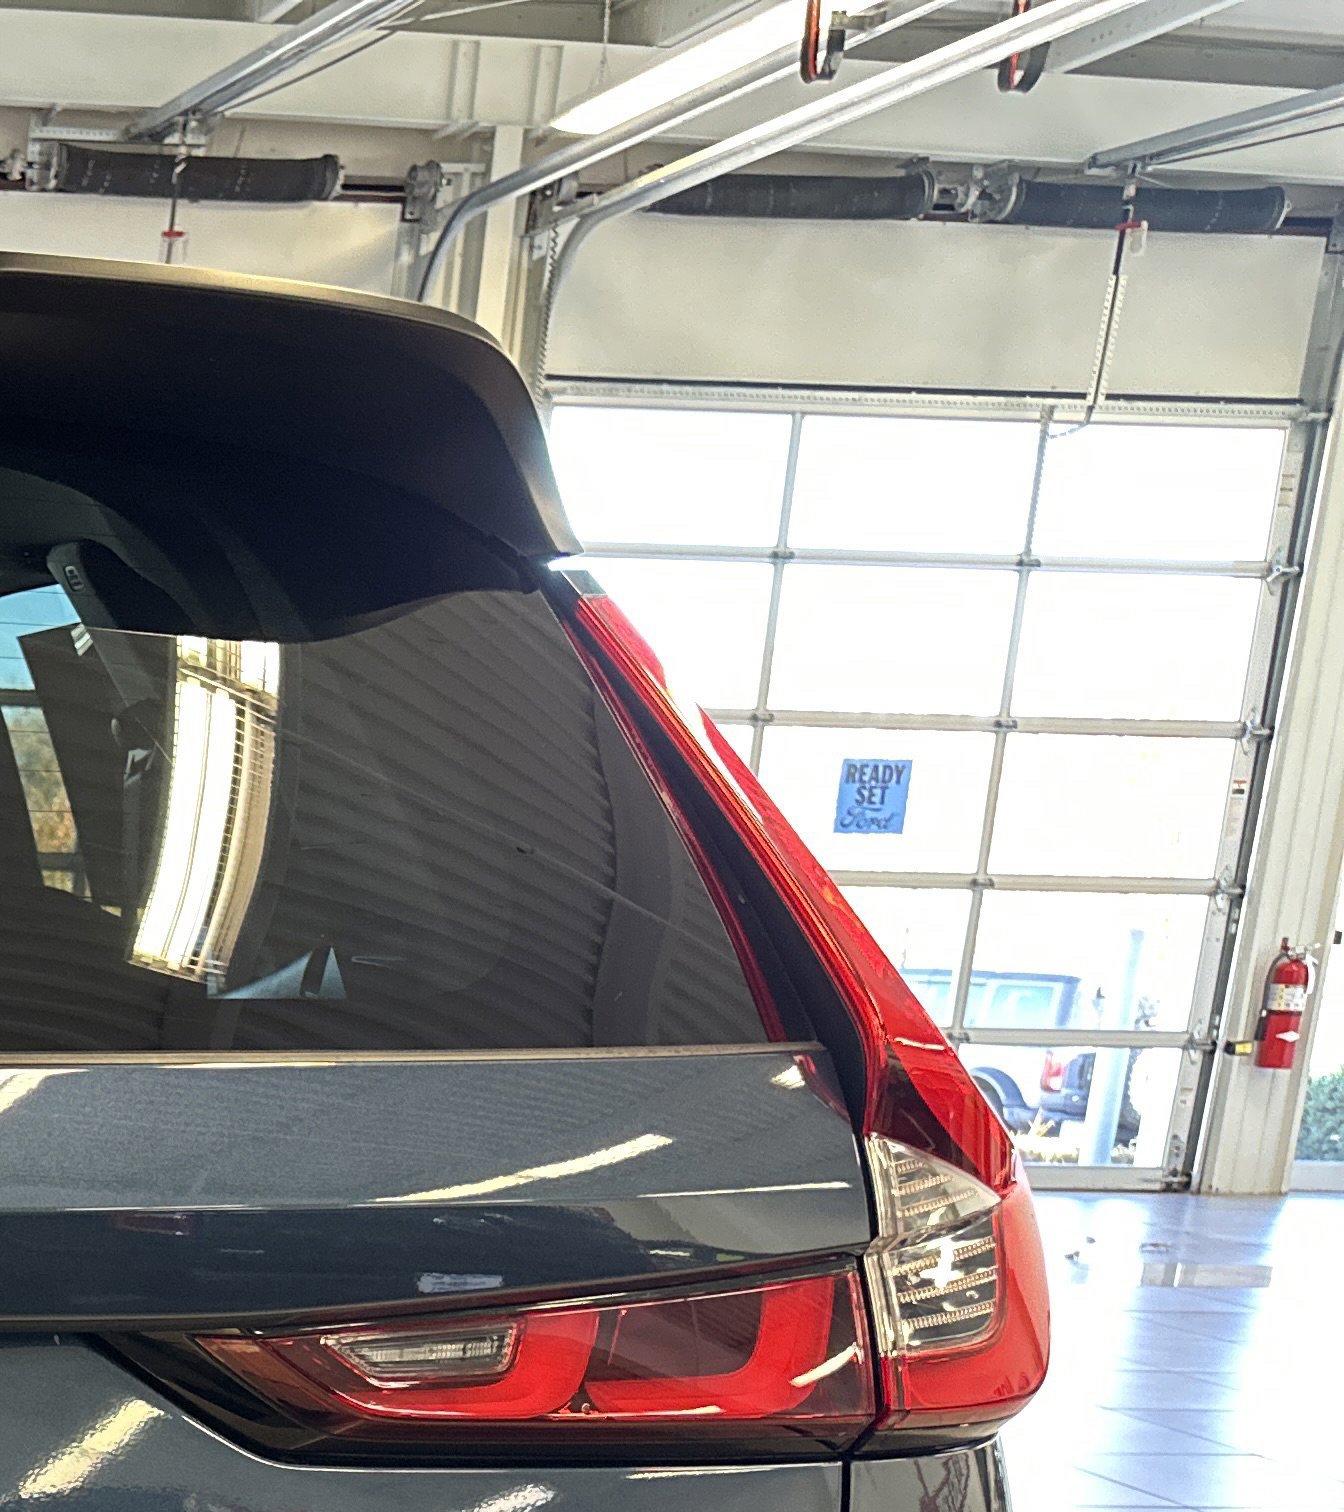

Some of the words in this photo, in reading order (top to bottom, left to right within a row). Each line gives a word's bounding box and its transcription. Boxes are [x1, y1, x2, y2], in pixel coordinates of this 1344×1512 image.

[845, 764, 907, 784] READY
[854, 785, 890, 806] SET
[839, 805, 898, 830] Ford
